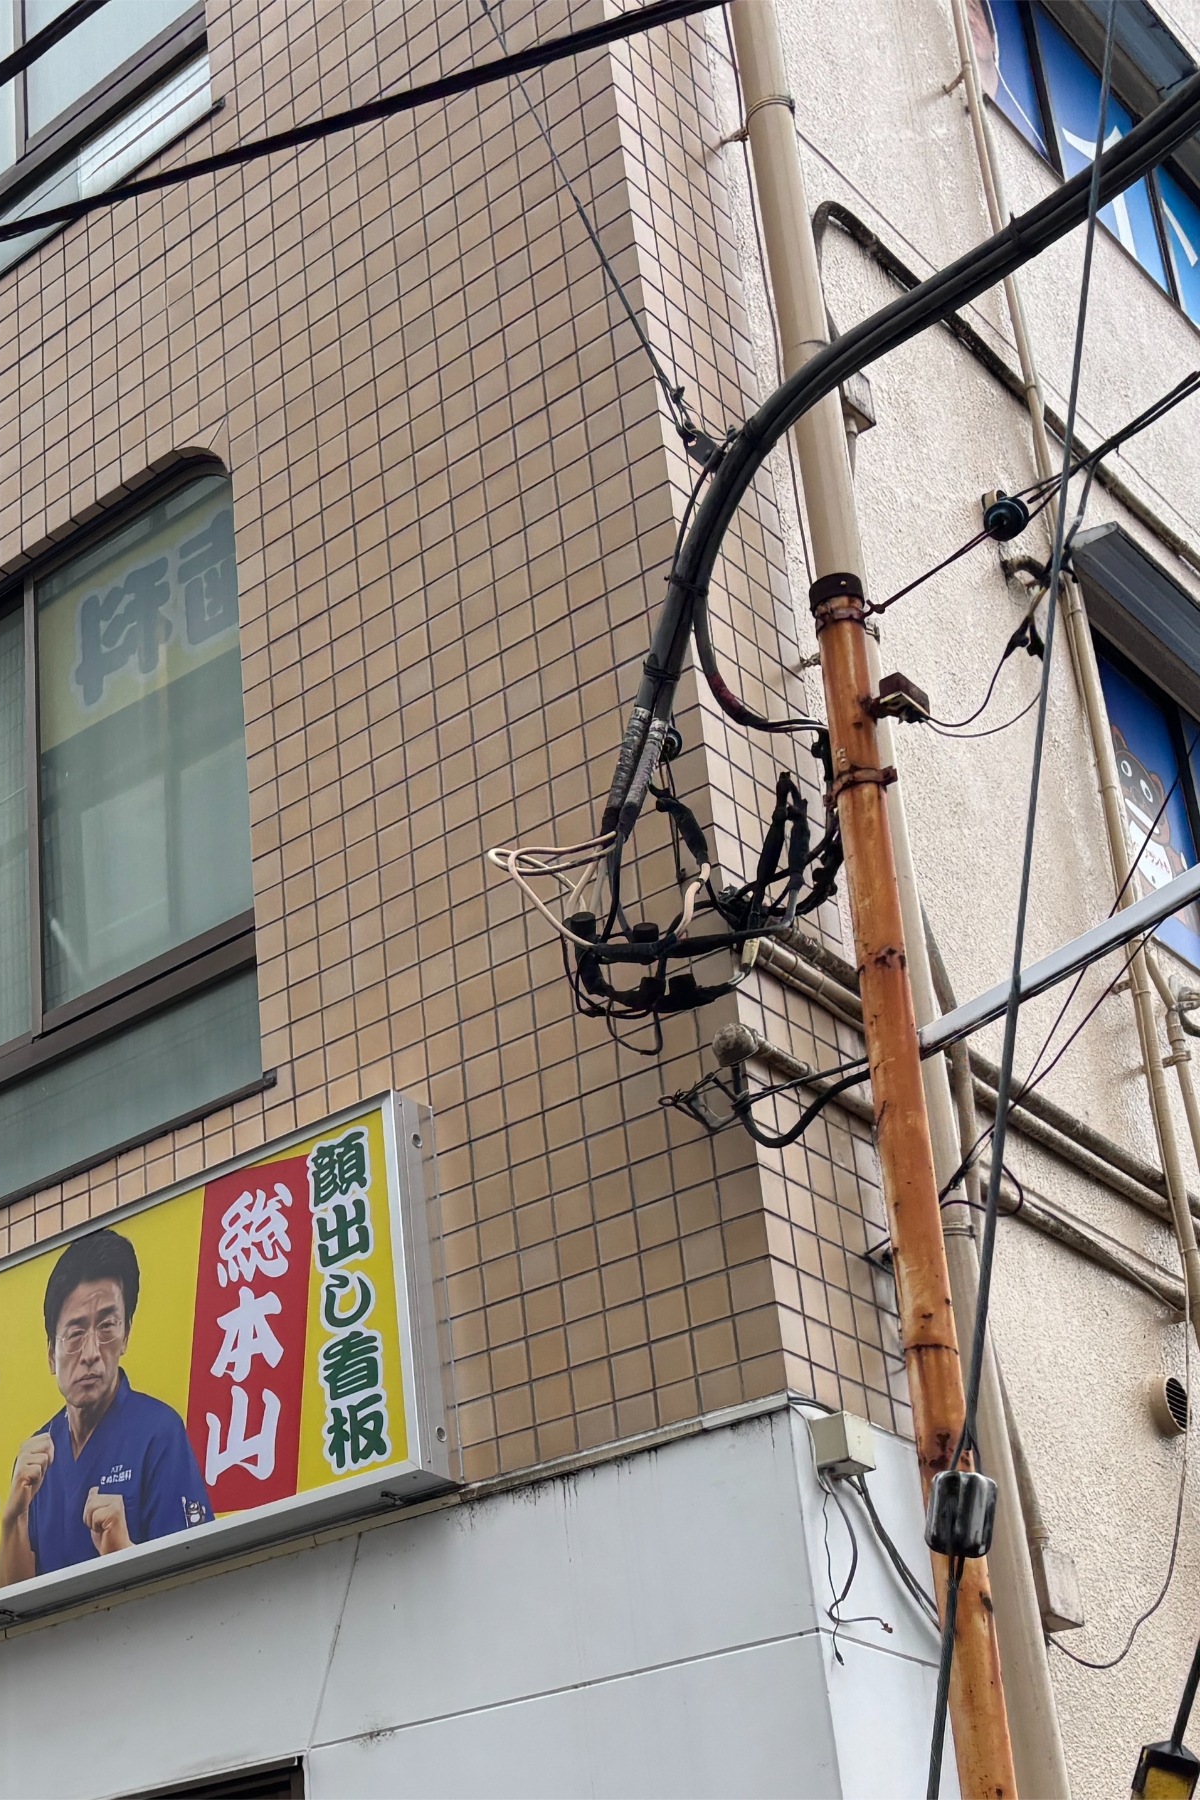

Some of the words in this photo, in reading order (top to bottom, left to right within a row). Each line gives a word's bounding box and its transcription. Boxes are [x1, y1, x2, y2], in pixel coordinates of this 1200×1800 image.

[204, 1182, 293, 1487] 総本山
[310, 1127, 390, 1473] 顔出し看板
